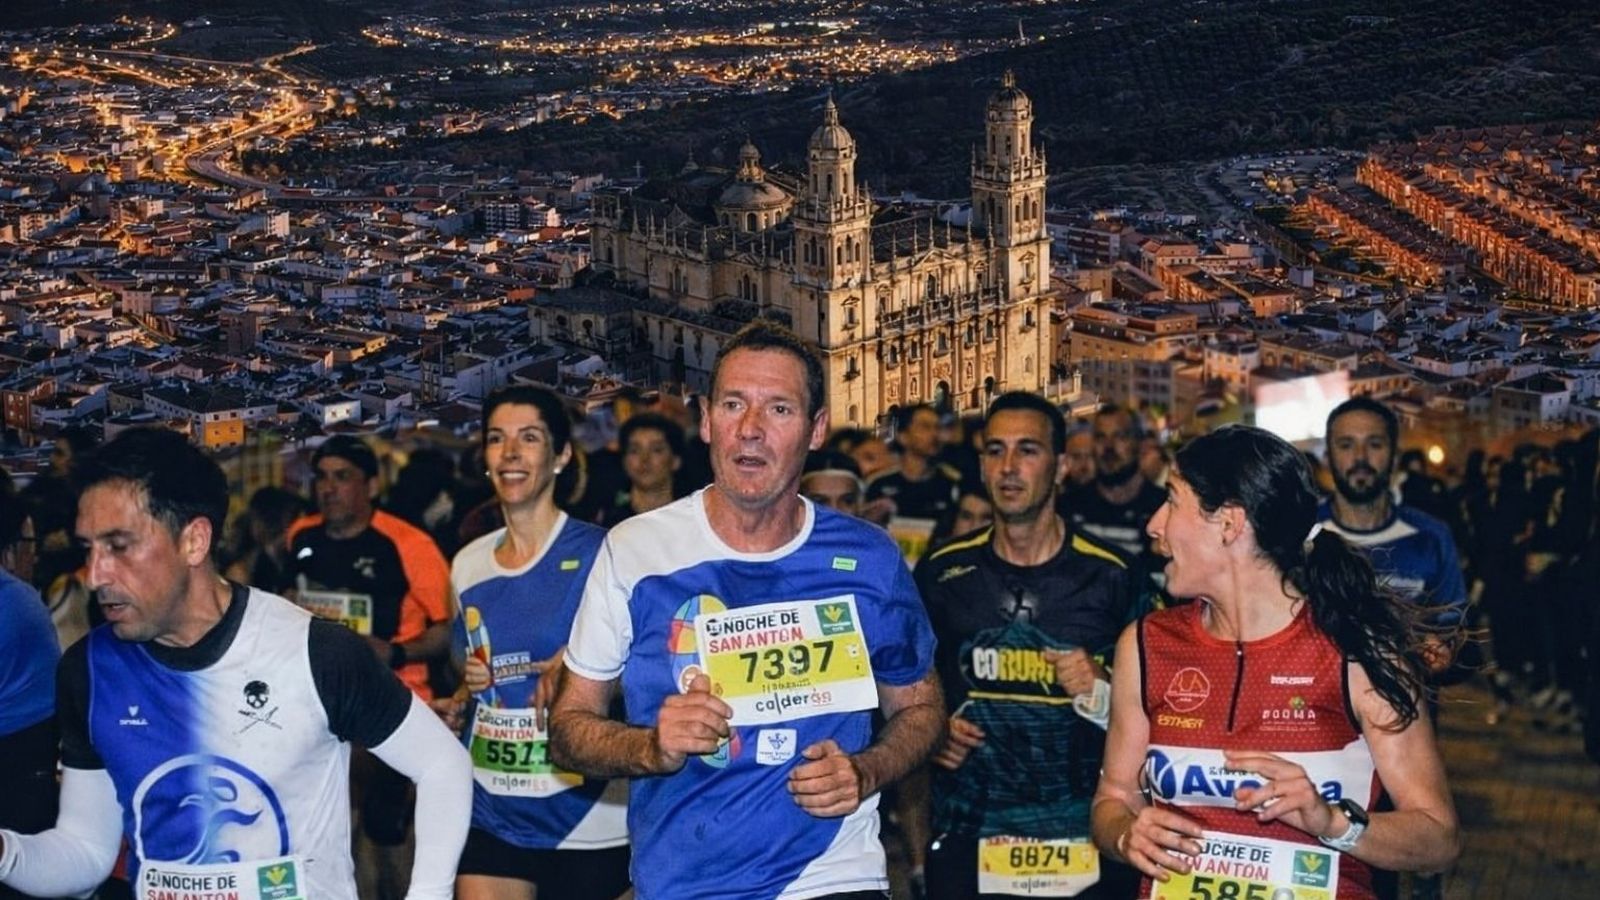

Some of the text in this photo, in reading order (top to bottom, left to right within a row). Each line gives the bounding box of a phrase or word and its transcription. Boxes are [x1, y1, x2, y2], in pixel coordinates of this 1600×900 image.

[724, 614, 777, 634] NOCHE
[780, 611, 800, 626] DE
[708, 635, 742, 654] SAN
[739, 640, 834, 683] 7397
[1199, 842, 1272, 864] OCHE DE
[1204, 859, 1270, 881] ANTON
[161, 875, 212, 890] NOCHE
[217, 874, 237, 888] DE
[147, 889, 177, 900] SAN
